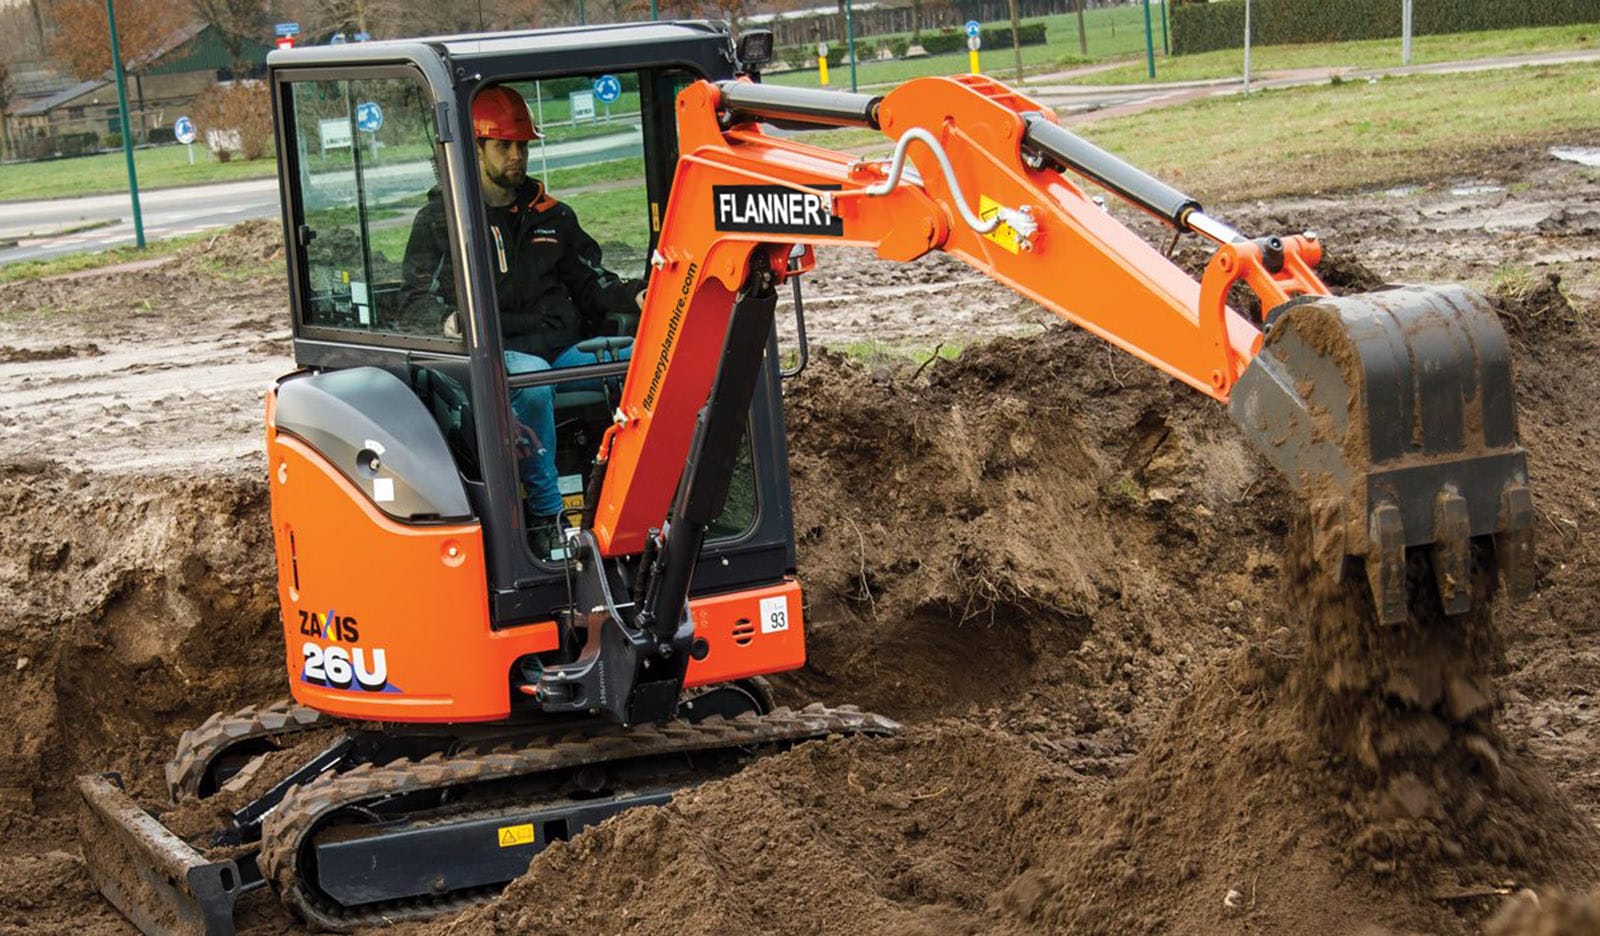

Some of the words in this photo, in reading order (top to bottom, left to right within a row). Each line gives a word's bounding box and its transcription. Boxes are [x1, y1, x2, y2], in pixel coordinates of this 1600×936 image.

[642, 262, 698, 412] flanneryplanthire.com
[299, 609, 359, 643] ZAXIS
[770, 611, 785, 629] 93
[303, 642, 387, 691] 26U
